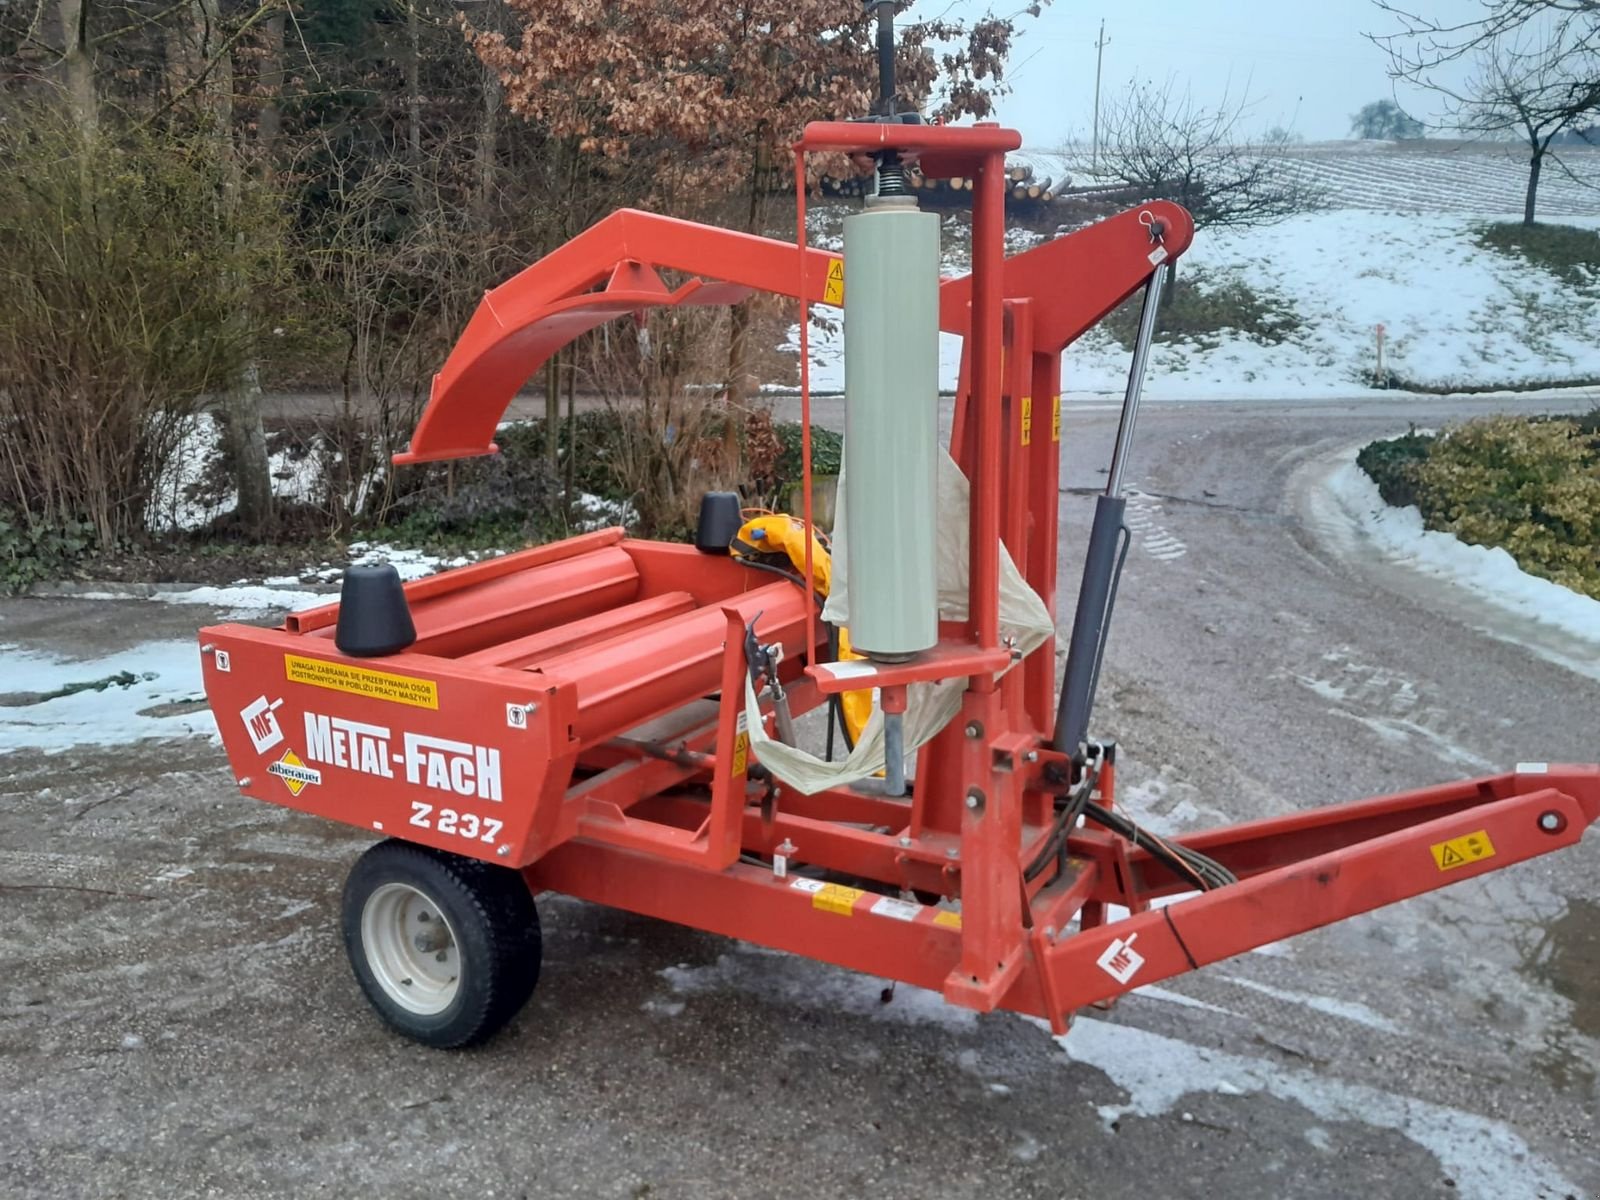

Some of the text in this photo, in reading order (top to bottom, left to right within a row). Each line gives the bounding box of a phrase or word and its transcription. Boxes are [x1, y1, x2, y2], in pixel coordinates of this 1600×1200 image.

[291, 670, 337, 684] POSTRONNYCH
[374, 685, 397, 697] PRACY
[398, 690, 431, 703] MASZYNY
[317, 665, 349, 678] ZABRANIA
[361, 673, 409, 690] PRZEBYWANIA
[410, 682, 431, 694] OSÓB
[249, 707, 273, 741] MF
[409, 801, 504, 844] Z 237
[1109, 944, 1131, 973] MF
